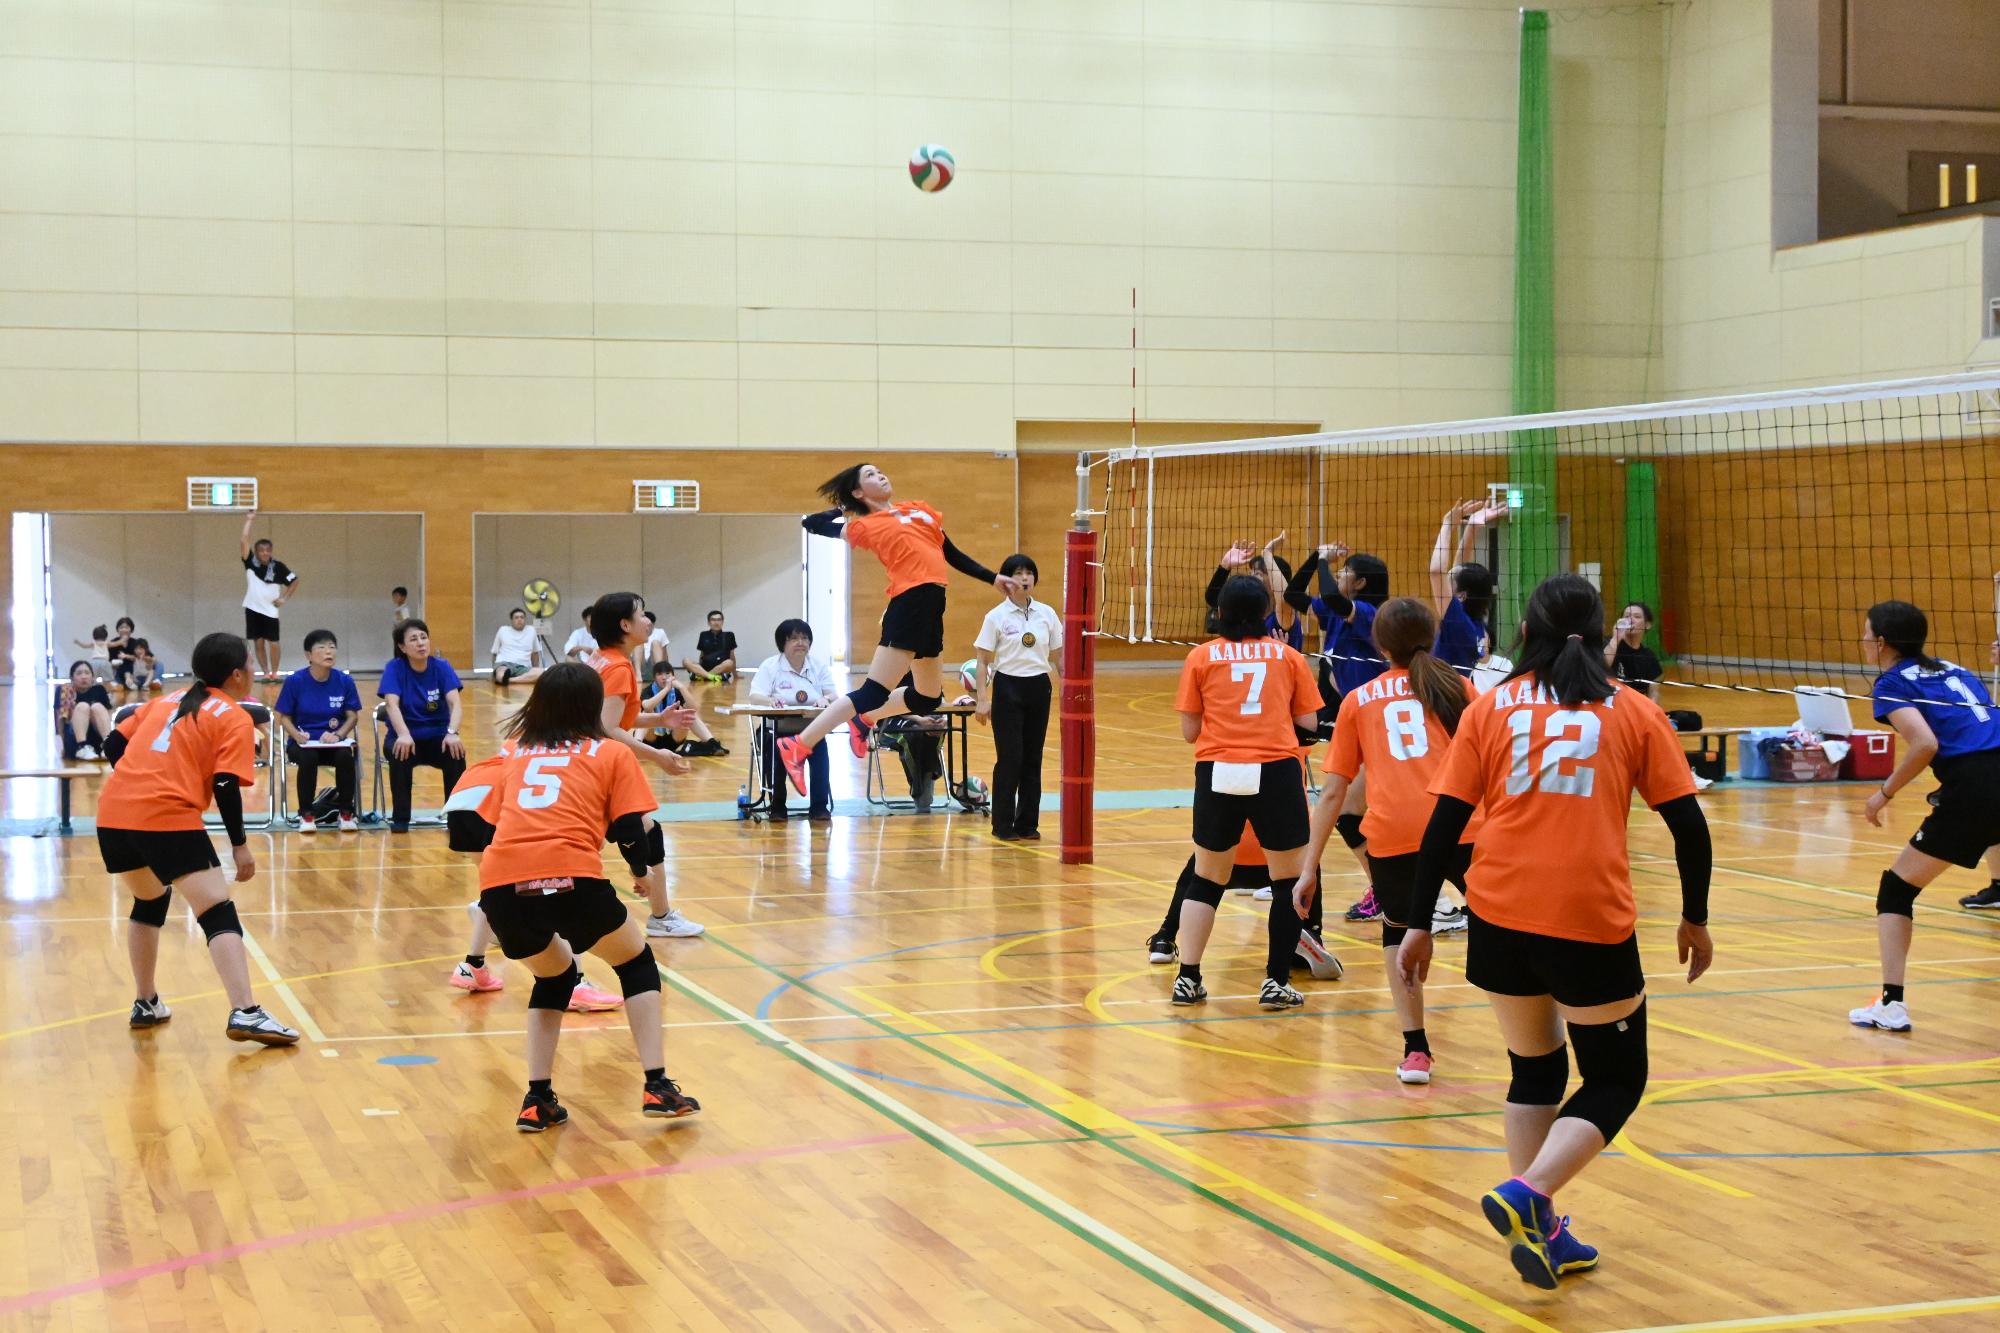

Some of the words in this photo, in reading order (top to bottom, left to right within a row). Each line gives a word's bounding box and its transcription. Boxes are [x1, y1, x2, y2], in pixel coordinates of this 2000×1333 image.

[1209, 643, 1284, 661] KAICITY
[1230, 662, 1267, 715] 7
[1357, 676, 1416, 707] KAIC
[1494, 680, 1621, 710] KAIY
[1944, 676, 1991, 722] 1
[1383, 699, 1429, 761] 8
[1505, 709, 1601, 797] 12
[517, 756, 571, 809] 5
